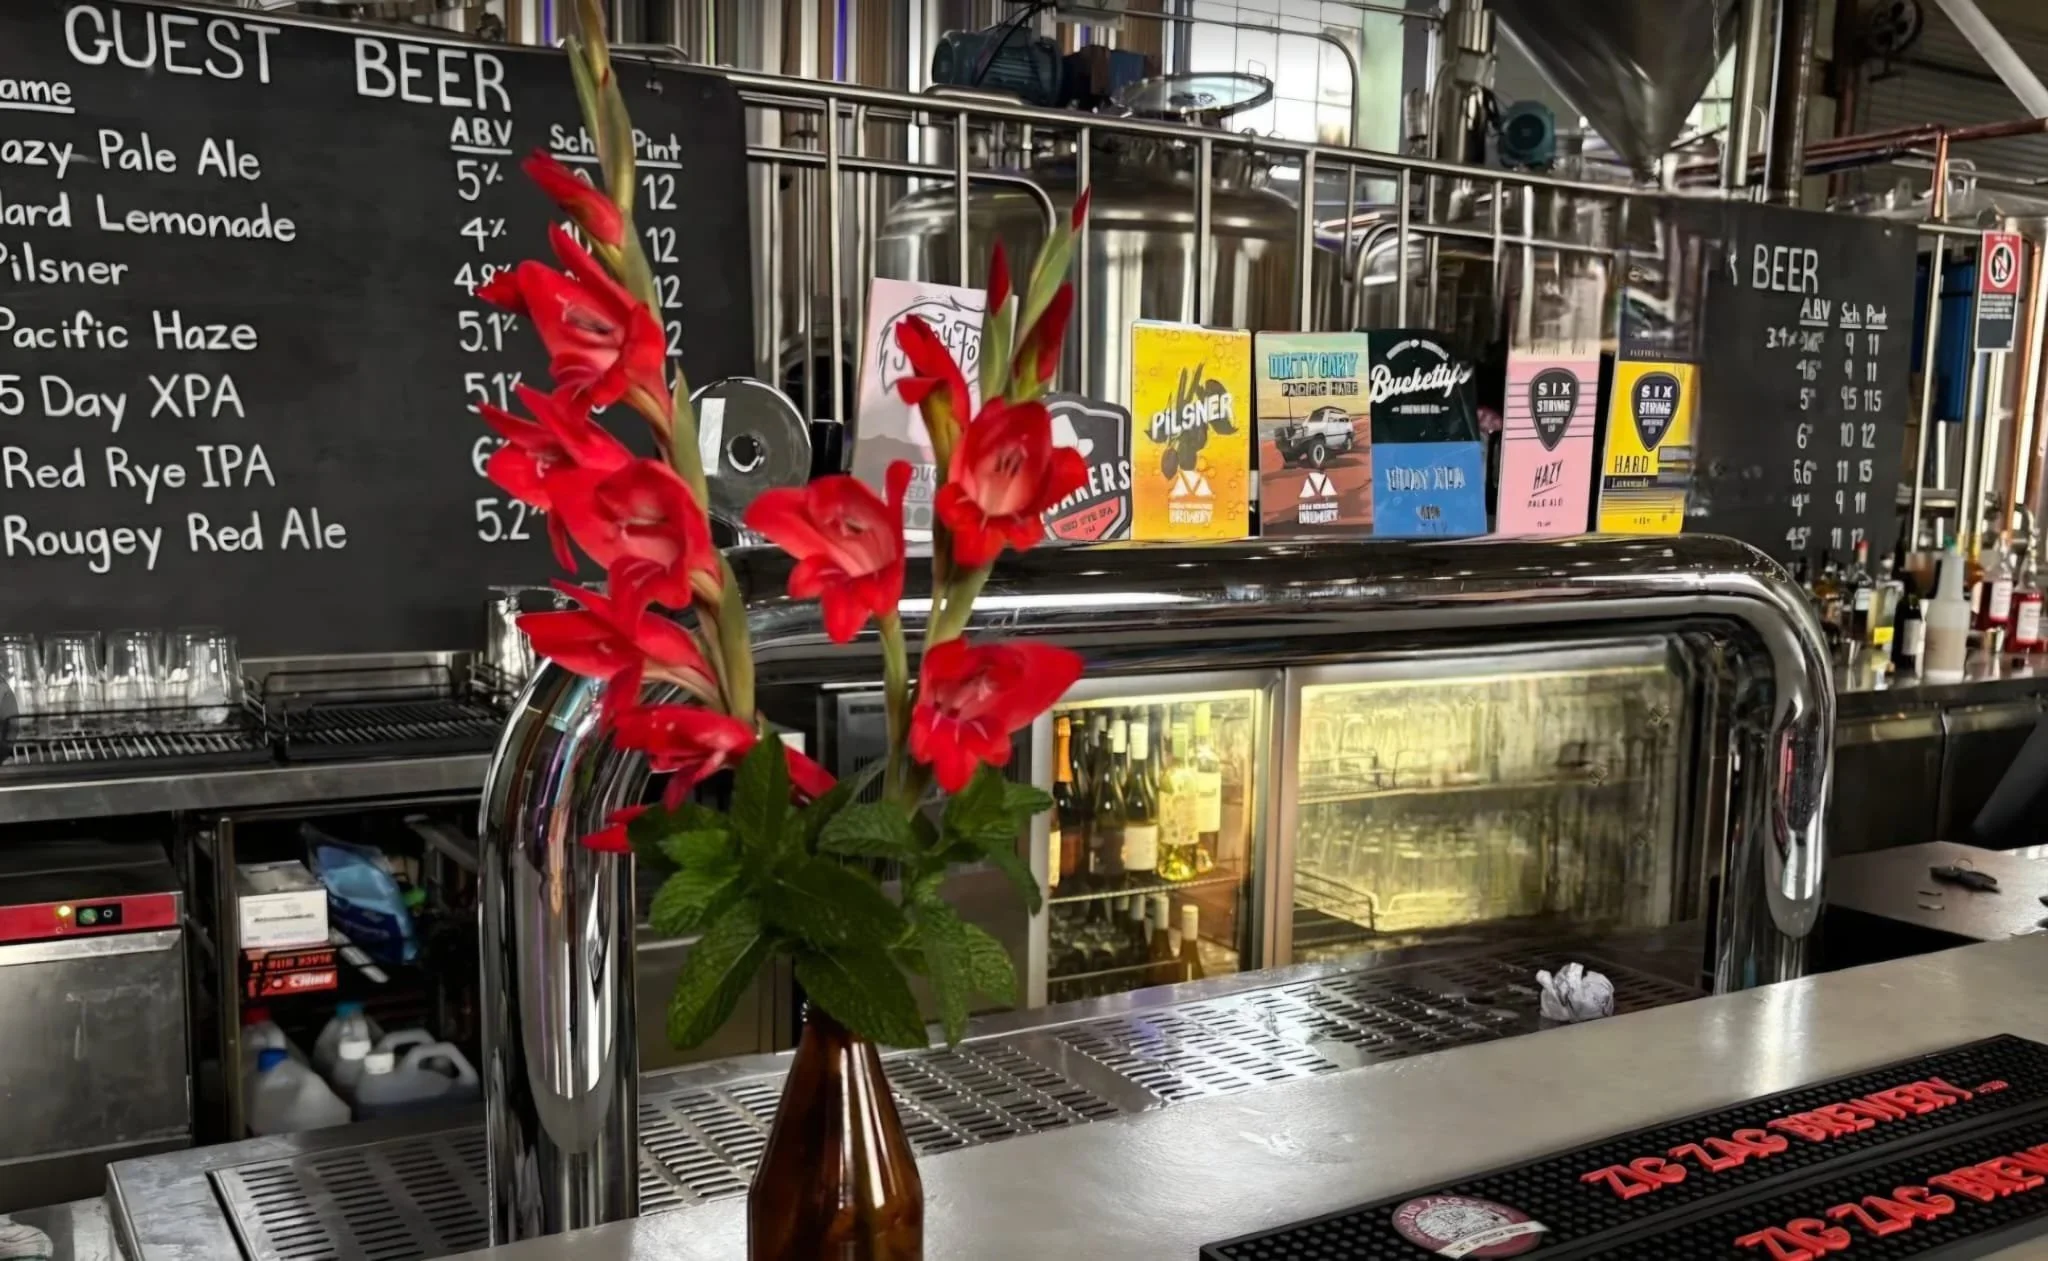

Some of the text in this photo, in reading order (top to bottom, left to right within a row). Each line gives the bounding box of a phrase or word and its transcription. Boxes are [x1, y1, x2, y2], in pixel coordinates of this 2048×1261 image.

[65, 4, 512, 112] GUEST BEER
[99, 129, 177, 173] Pale
[198, 139, 261, 180] Ale
[550, 124, 596, 154] Sch
[632, 129, 681, 160] Pint
[457, 160, 503, 201] 5%
[643, 174, 677, 210] 12
[0, 190, 296, 242] ard Lemonade
[460, 217, 507, 252] 4%
[646, 227, 679, 263] 12
[1753, 244, 1818, 293] BEER
[652, 275, 683, 308] 12
[1840, 301, 1860, 323] Sch
[154, 311, 258, 350] Haze
[458, 310, 518, 352] 5.1%
[666, 320, 683, 356] 2
[1846, 332, 1854, 354] 9
[1868, 334, 1879, 355] 11
[1845, 360, 1852, 379] 9
[1867, 362, 1877, 382] 11
[40, 375, 127, 432] Day
[150, 374, 245, 418] XPA
[1538, 382, 1570, 396] SIX
[1641, 385, 1673, 398] SIX
[1537, 400, 1570, 413] STRING
[1639, 402, 1671, 414] STRING
[1841, 423, 1854, 447] 10
[1861, 423, 1875, 448] 12
[4, 444, 276, 504] Red Rye IPA
[1533, 459, 1564, 489] HAZY
[1614, 455, 1649, 474] HARD
[1837, 460, 1848, 483] 11
[1836, 490, 1843, 514] 9
[1855, 492, 1866, 513] 11
[5, 508, 347, 573] Rougey Red Ale
[1832, 528, 1842, 549] 11
[1580, 1076, 1973, 1199] ZIG ZAG BREWERY
[1827, 1185, 1955, 1236] ZAG
